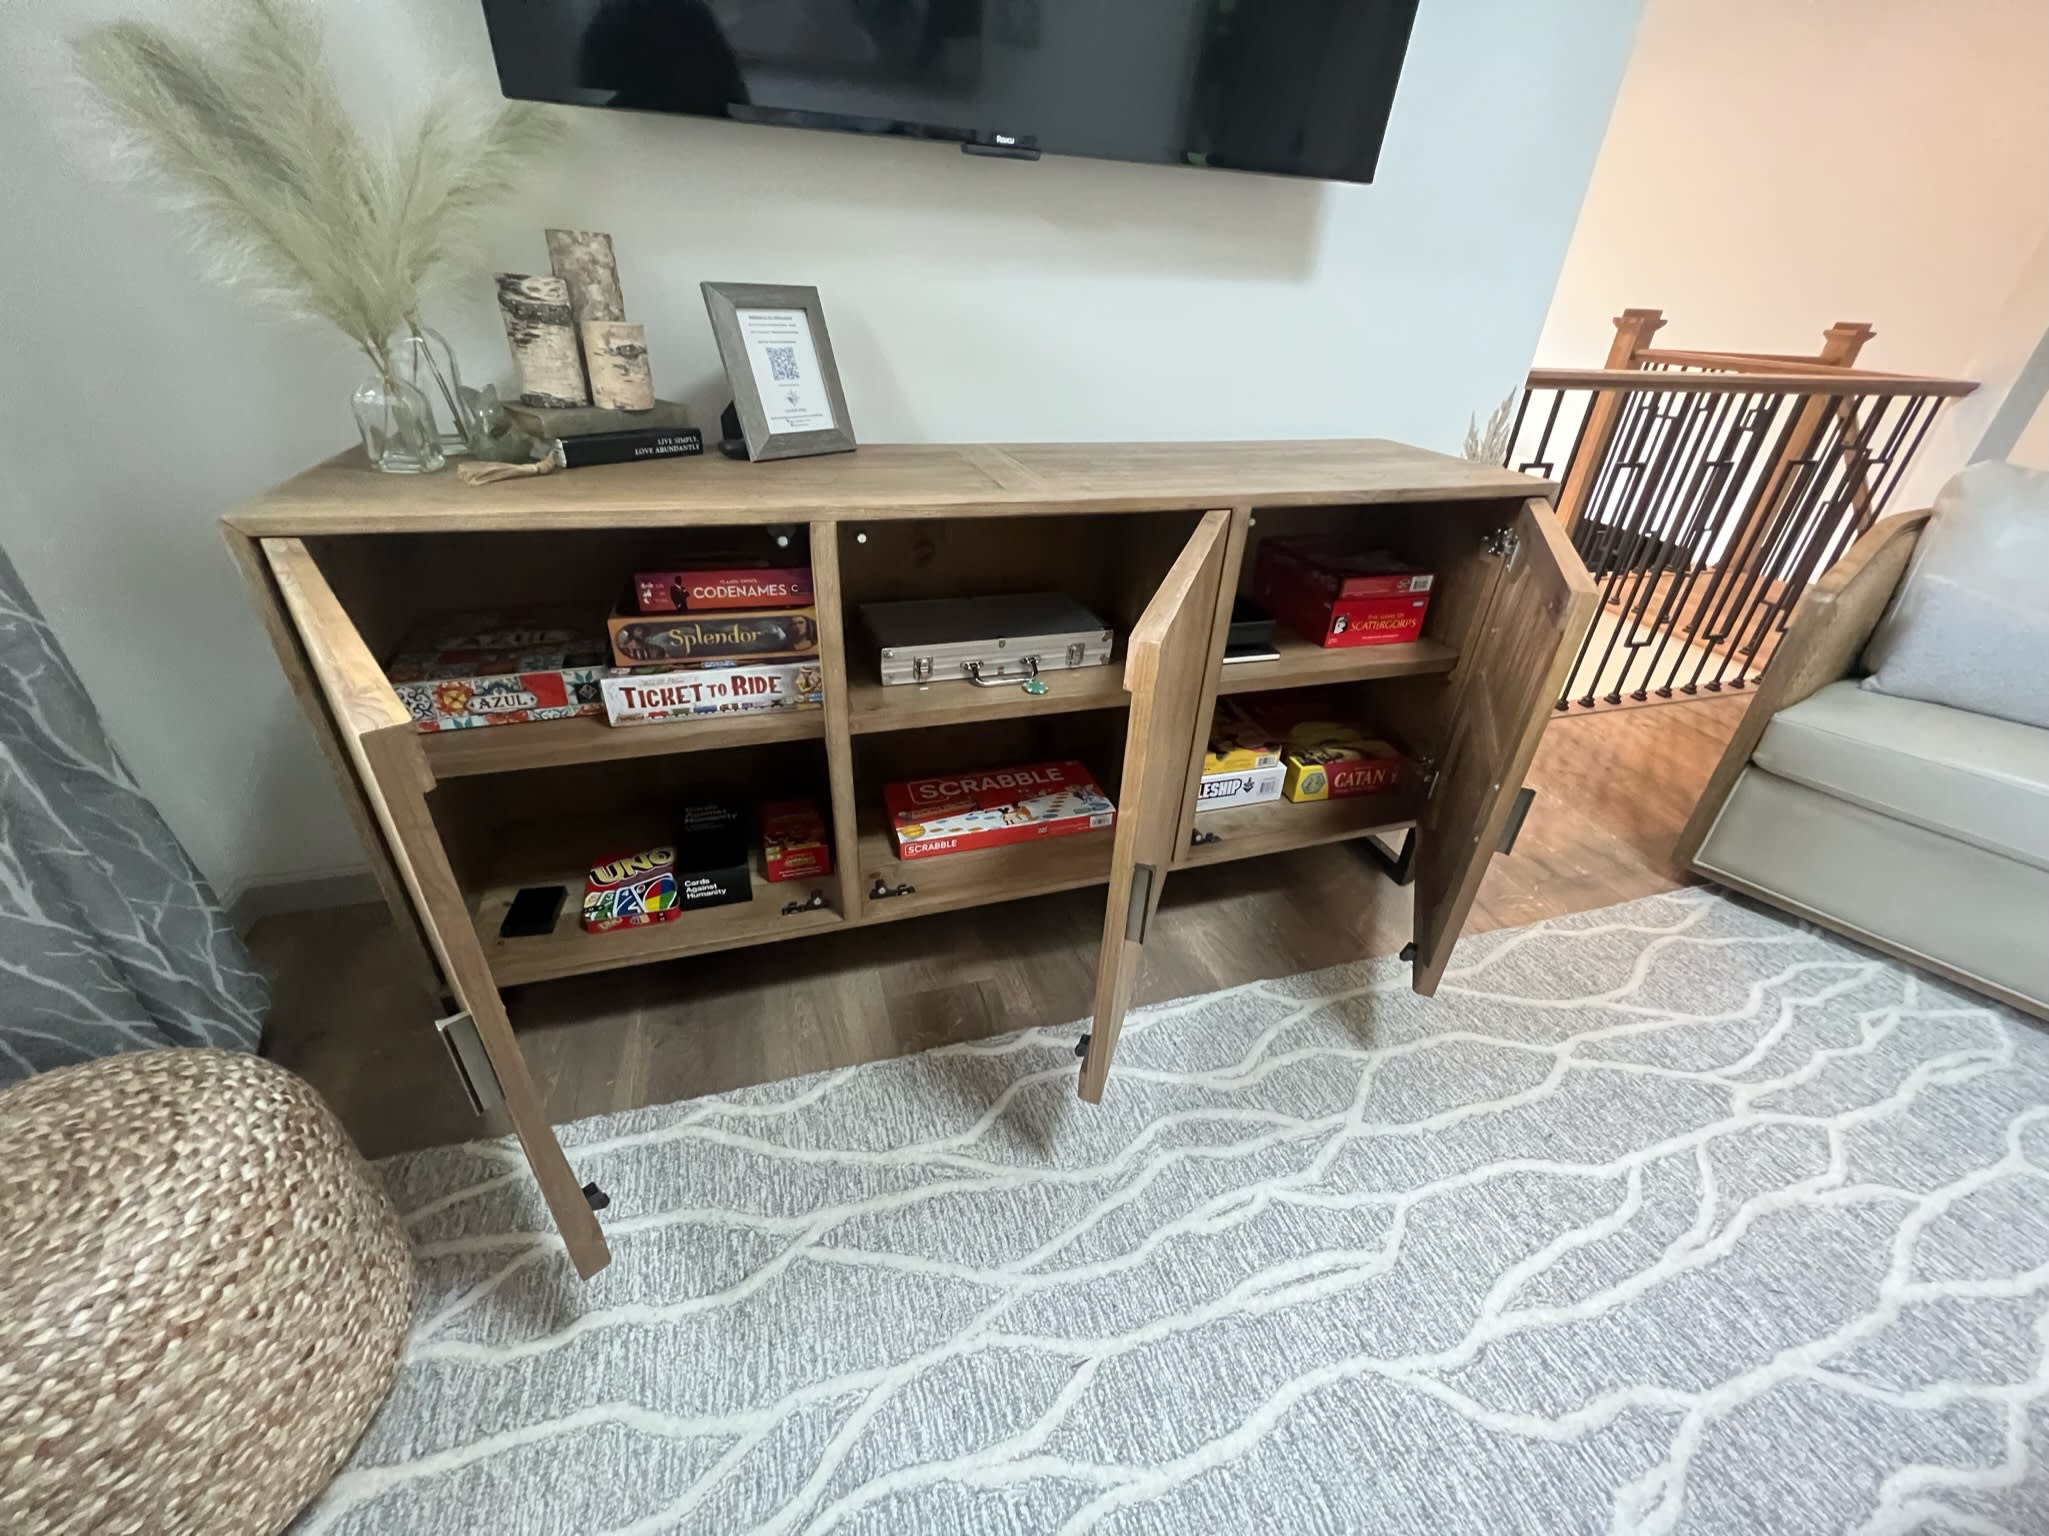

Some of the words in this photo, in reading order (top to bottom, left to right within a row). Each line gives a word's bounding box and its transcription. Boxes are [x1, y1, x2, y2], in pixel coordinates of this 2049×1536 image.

[634, 447, 654, 456] LOVE
[655, 443, 700, 455] ABUNDANTLY
[657, 438, 673, 446] LIVE
[692, 584, 788, 600] CODENAMES
[667, 623, 762, 656] Splendor
[618, 683, 703, 709] TICKET
[706, 683, 728, 698] TO
[730, 675, 783, 697] RIDE
[478, 694, 528, 711] AZUL
[918, 767, 1065, 801] SCRABBLE
[1333, 768, 1387, 789] CATAN
[907, 839, 958, 855] SCRABBLE
[588, 847, 675, 887] UNO
[684, 878, 711, 888] Cards
[686, 883, 718, 893] Against
[686, 888, 727, 900] Humanity
